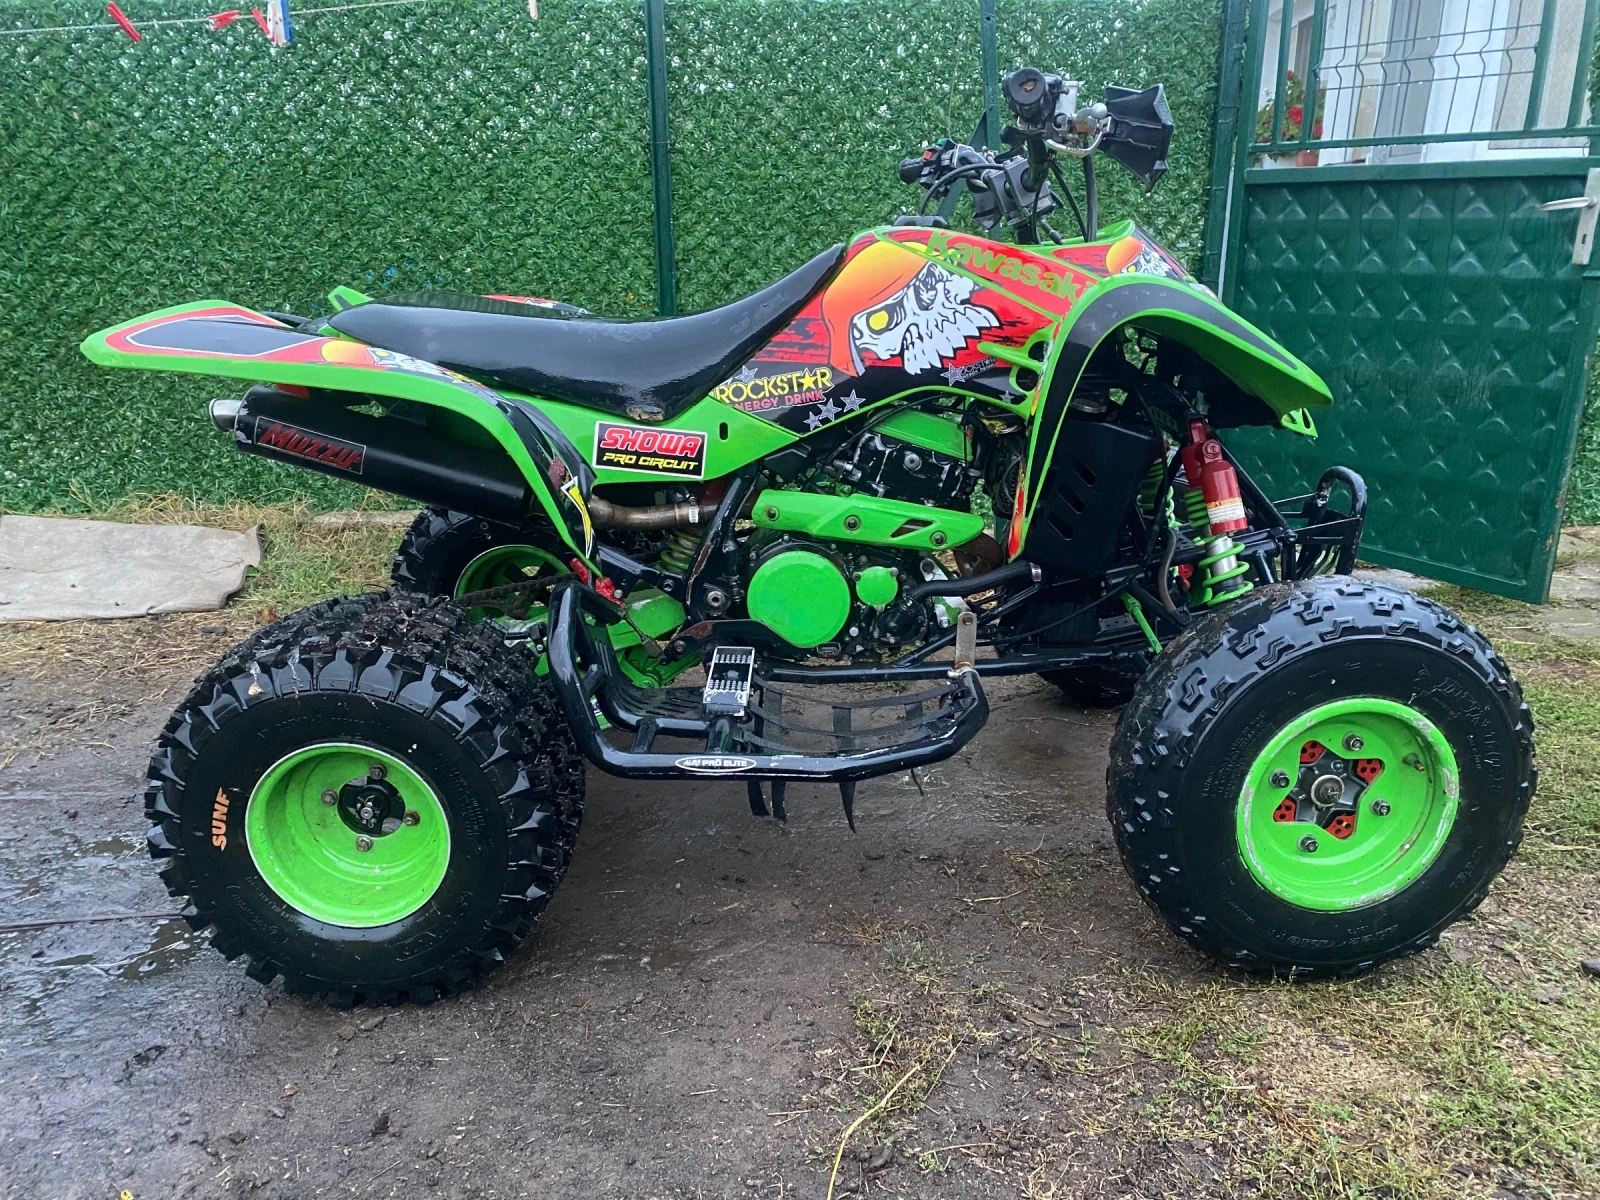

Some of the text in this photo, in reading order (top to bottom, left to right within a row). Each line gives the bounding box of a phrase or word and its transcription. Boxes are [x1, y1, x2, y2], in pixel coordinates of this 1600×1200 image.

[730, 389, 824, 412] NERGY DRINK
[600, 427, 703, 457] SHOWA
[602, 452, 699, 471] PRO CIRCUIT
[702, 759, 722, 767] PRO
[212, 787, 230, 851] SUNF
